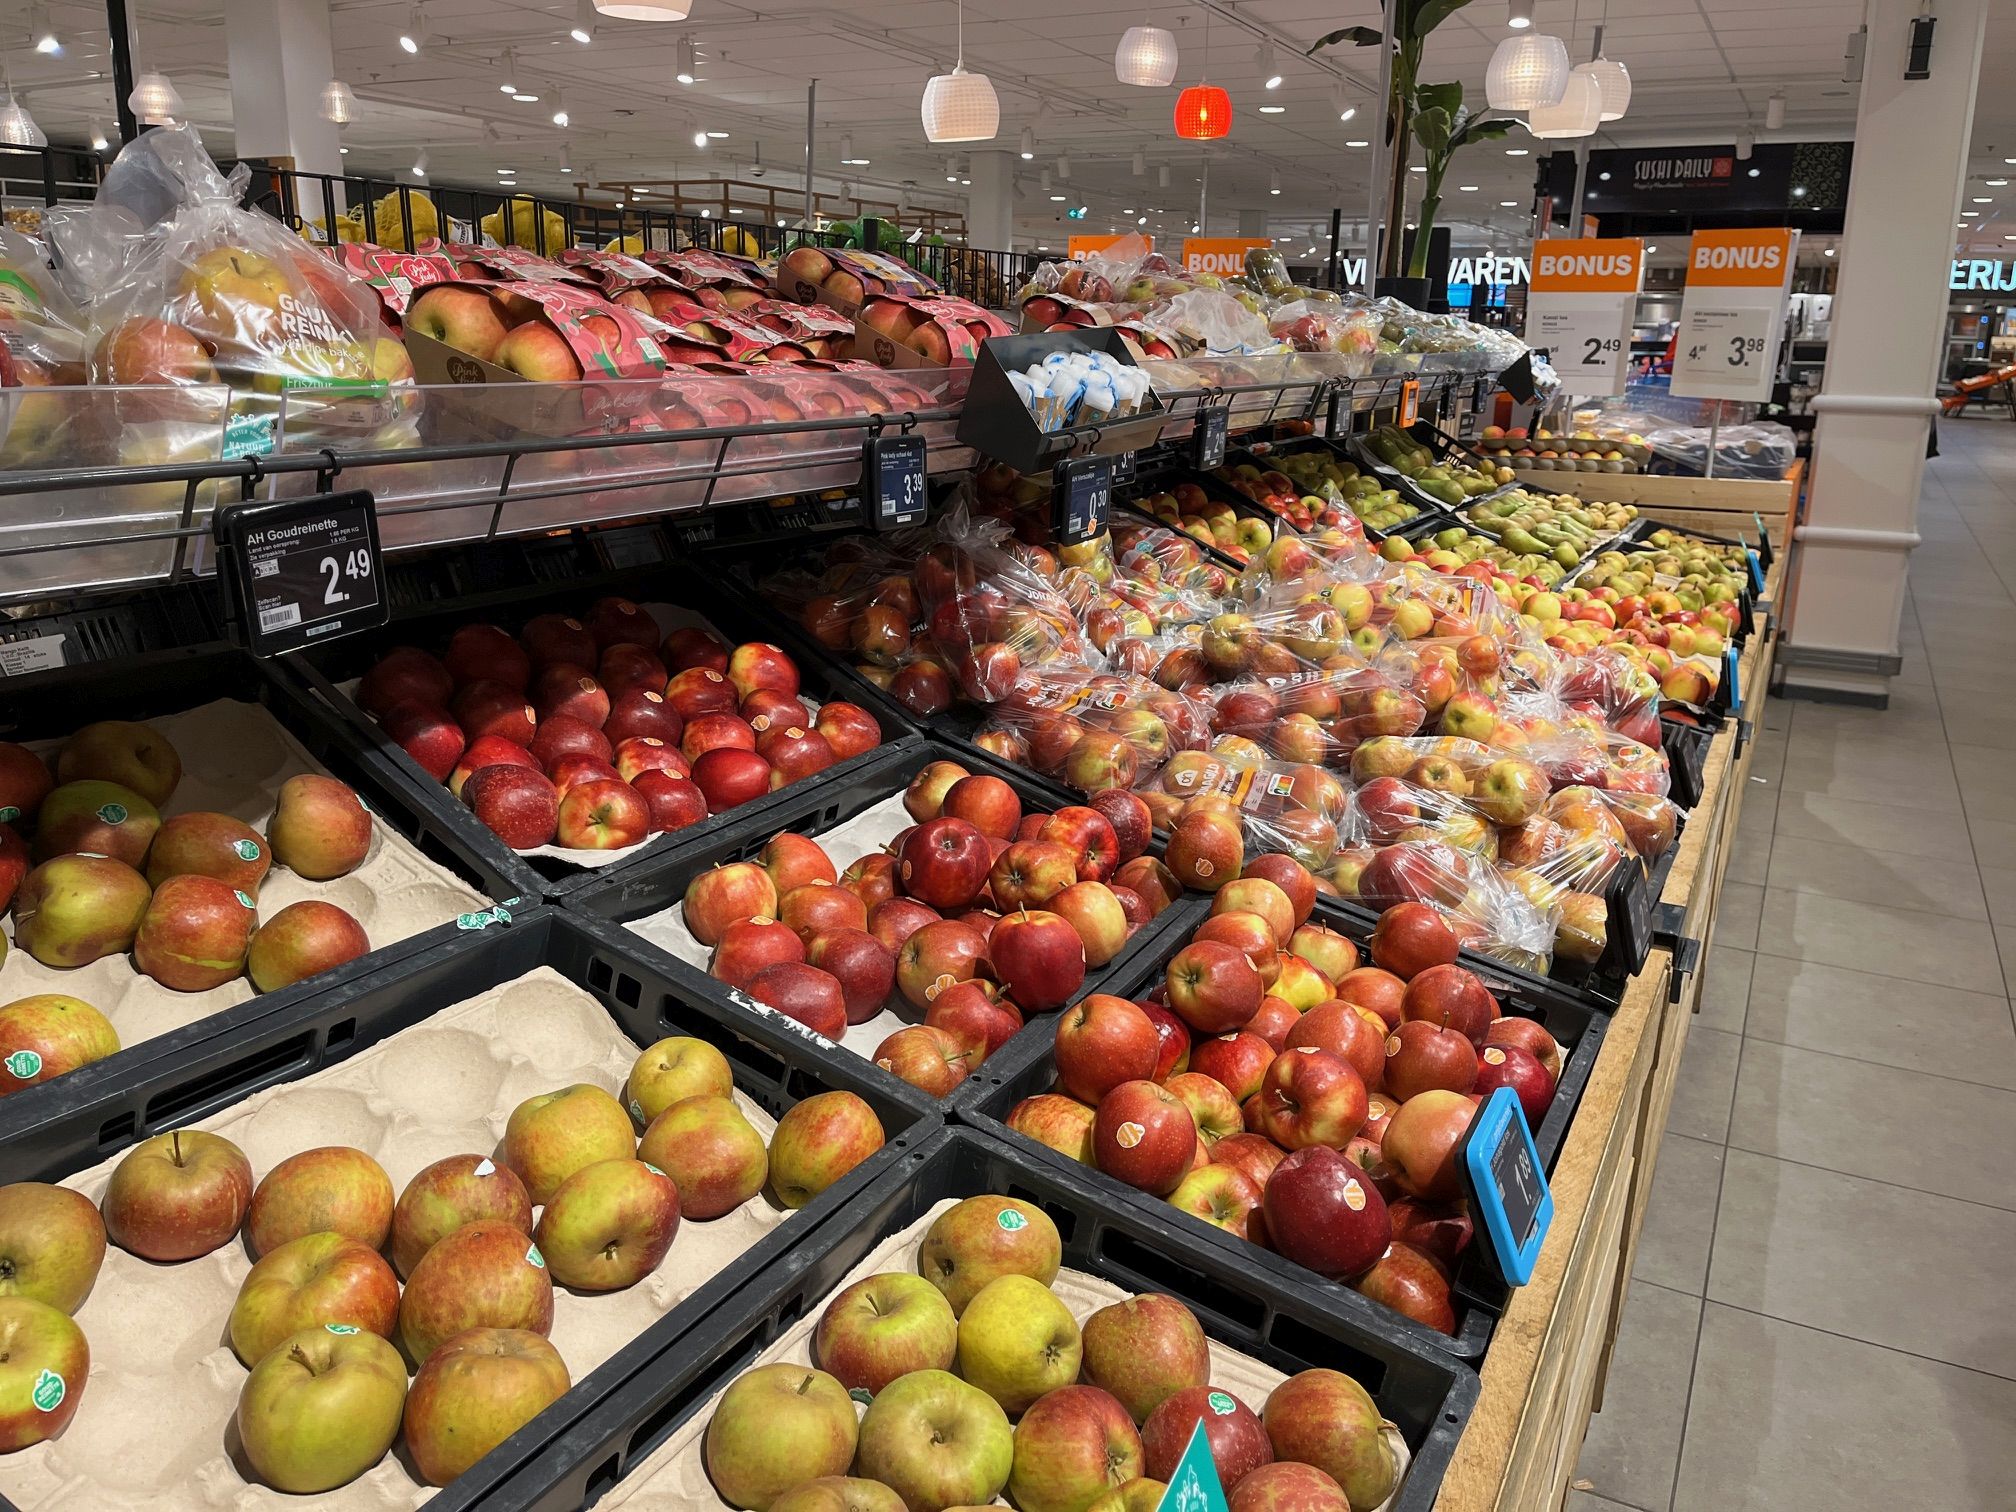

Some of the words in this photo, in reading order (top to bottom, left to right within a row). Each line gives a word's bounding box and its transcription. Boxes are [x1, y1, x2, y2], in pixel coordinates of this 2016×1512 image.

[1634, 160, 1672, 180] SUSHI
[1674, 159, 1713, 178] DAILY
[1188, 252, 1248, 273] BONU
[1539, 254, 1633, 276] BONUS
[1694, 245, 1781, 269] BONUS
[1582, 337, 1622, 365] 2.49
[1728, 336, 1765, 367] 3.98
[452, 362, 478, 378] Pink
[229, 441, 265, 452] NATUUR
[904, 472, 923, 505] 3.39
[1089, 489, 1107, 519] 0.30
[247, 531, 265, 546] AH
[267, 518, 338, 541] Goudreinette
[319, 548, 371, 605] 2.49
[1514, 1148, 1533, 1206] 1.89
